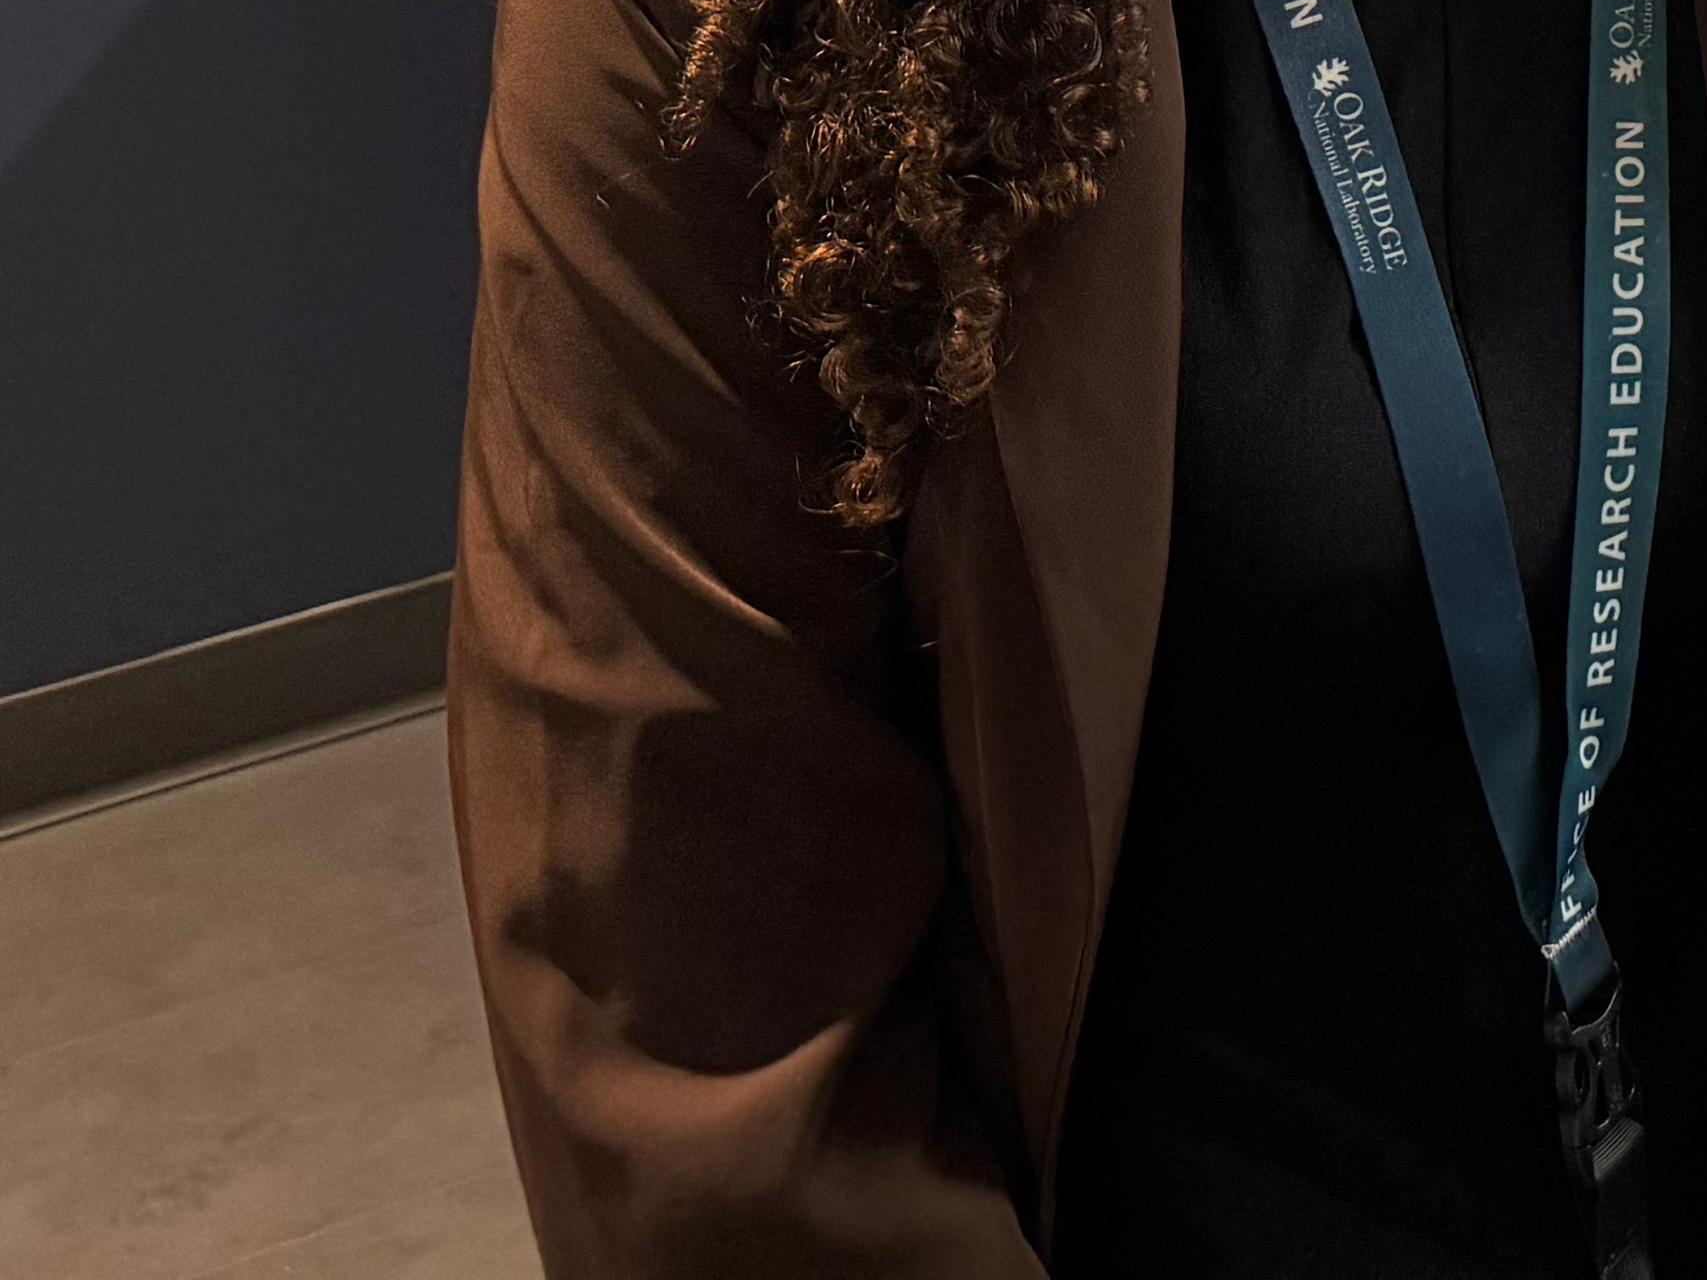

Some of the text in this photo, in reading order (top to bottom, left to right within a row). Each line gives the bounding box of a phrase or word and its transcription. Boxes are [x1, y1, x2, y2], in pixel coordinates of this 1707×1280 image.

[1308, 100, 1377, 275] National Laboratory
[1333, 91, 1408, 271] OAK RIDGE
[1609, 120, 1646, 406] EDUCATION
[1586, 426, 1639, 688] RESEARCH
[1579, 706, 1606, 770] OF
